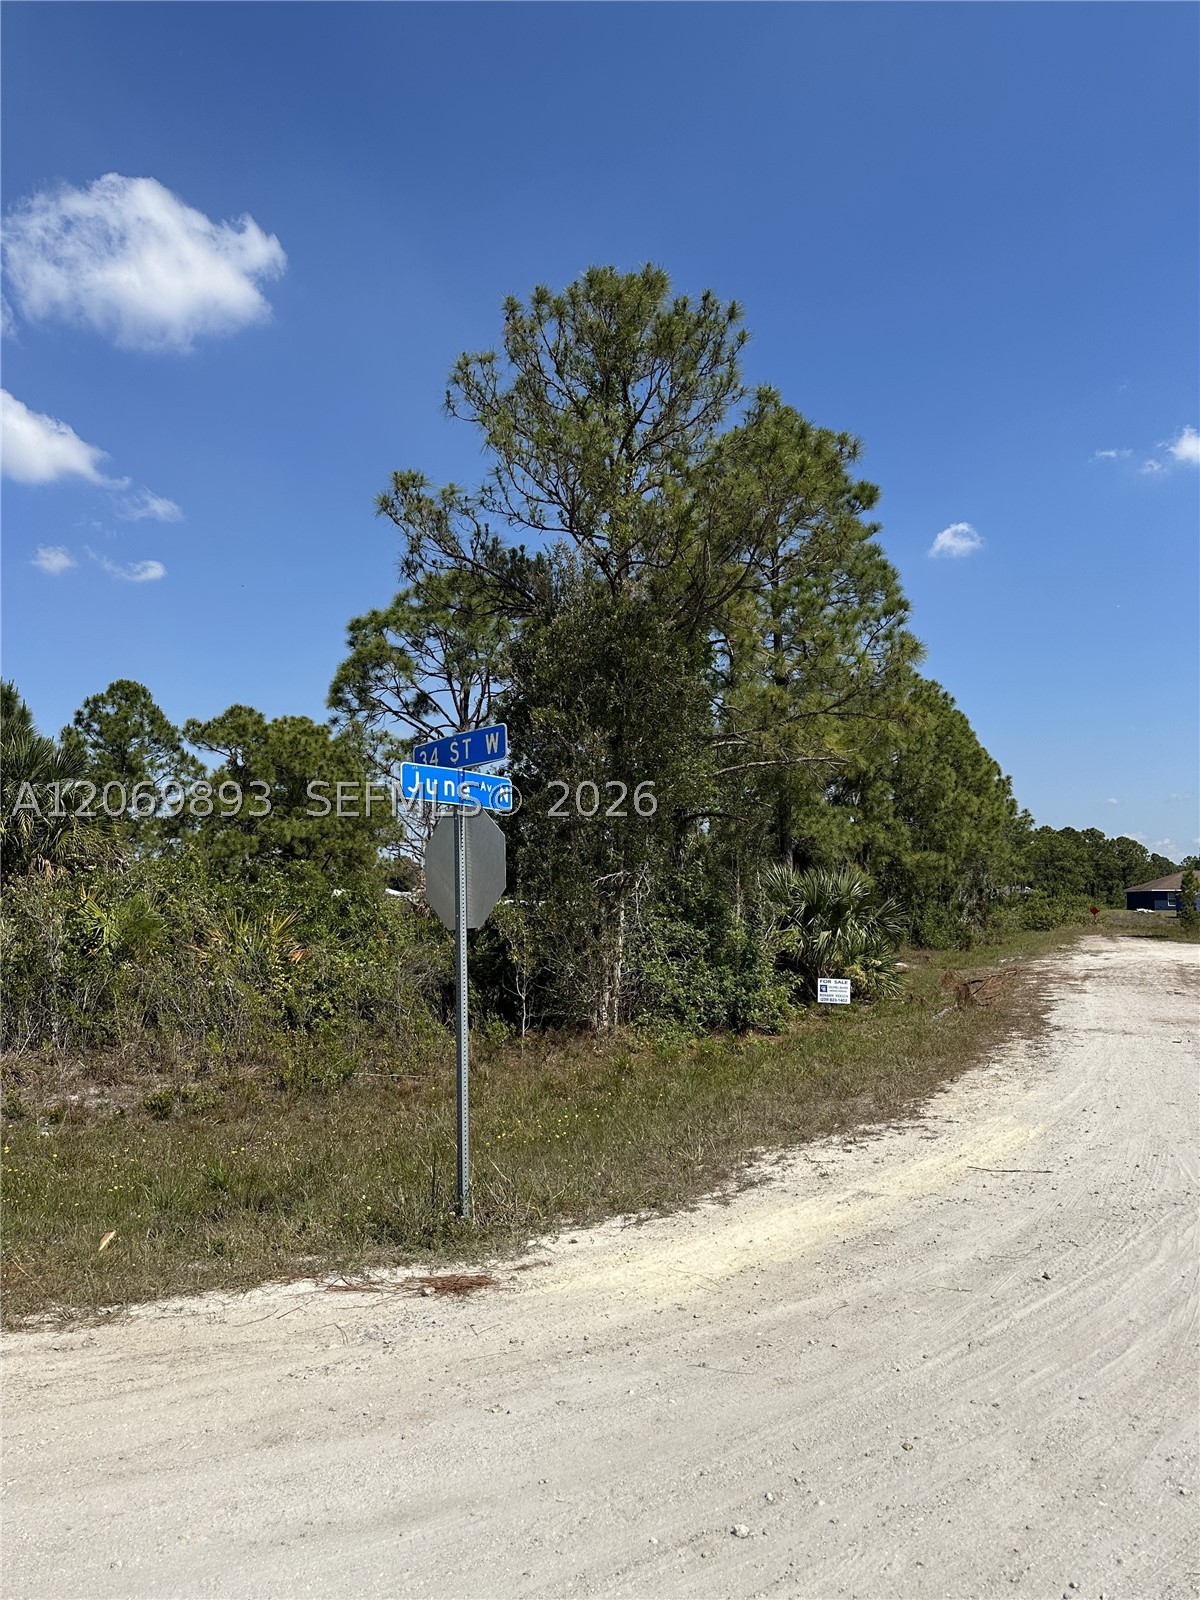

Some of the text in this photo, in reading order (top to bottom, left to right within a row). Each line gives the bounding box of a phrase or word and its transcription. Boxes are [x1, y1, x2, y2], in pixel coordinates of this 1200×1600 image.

[419, 732, 499, 765] 34 ST W
